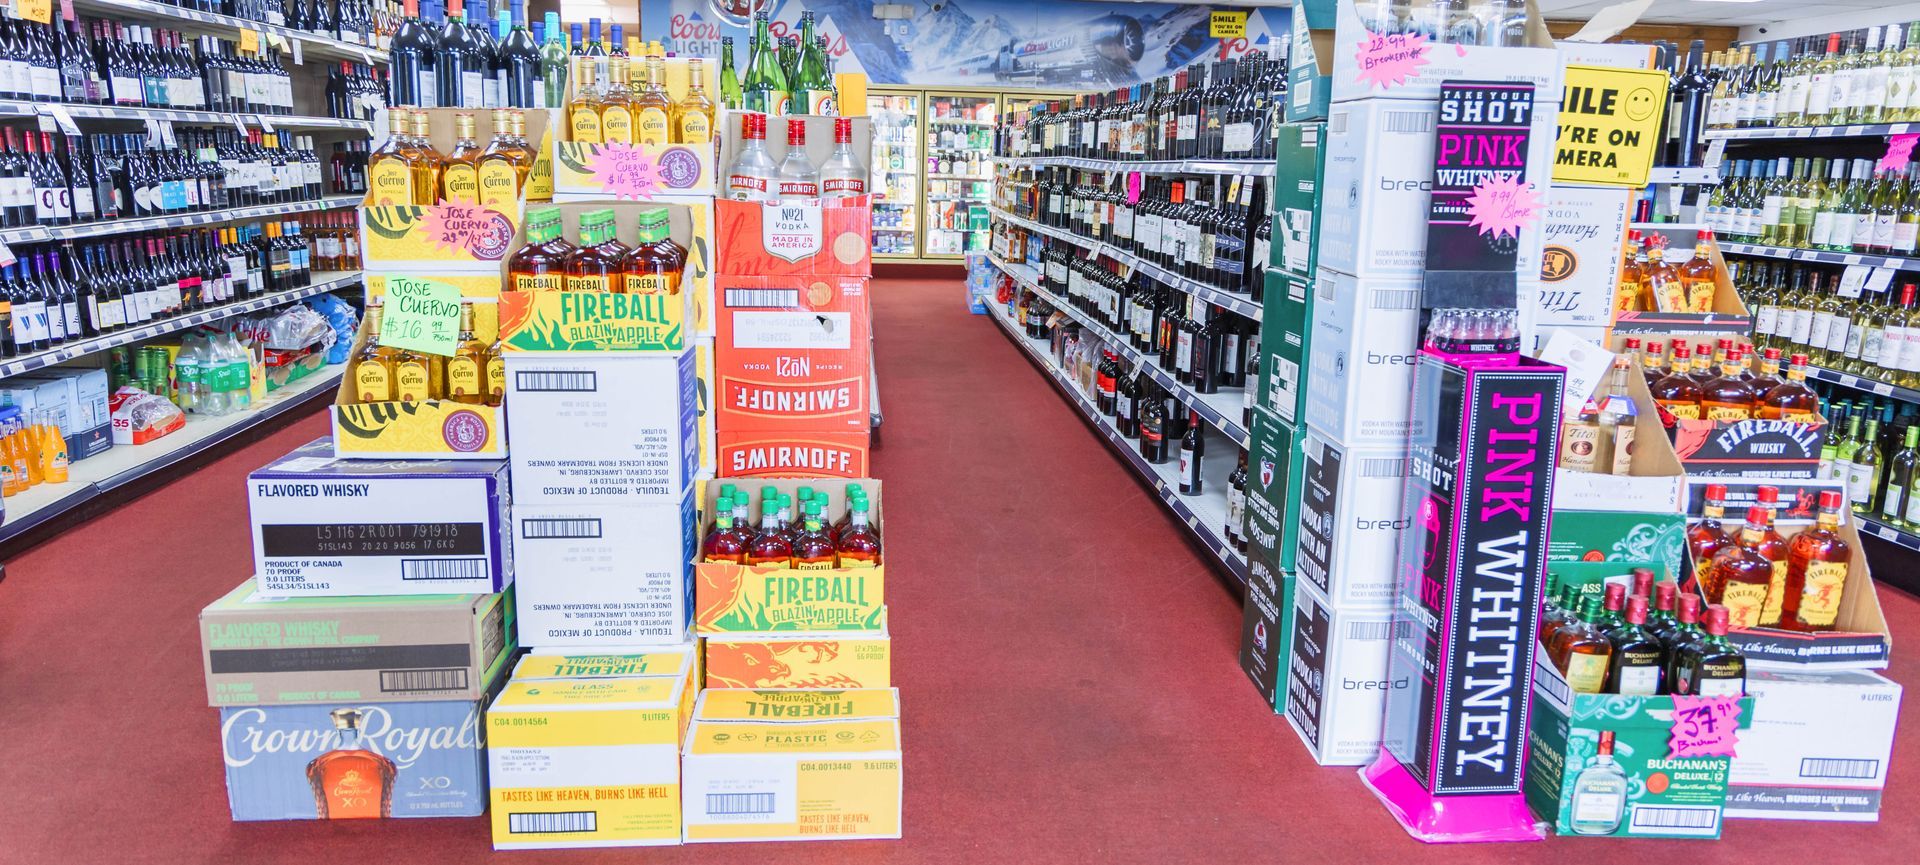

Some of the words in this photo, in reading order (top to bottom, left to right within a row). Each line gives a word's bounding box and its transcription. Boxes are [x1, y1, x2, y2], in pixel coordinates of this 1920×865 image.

[1212, 15, 1237, 23] SMILE
[670, 14, 721, 40] Coors
[674, 41, 719, 55] LIGHT
[1443, 90, 1483, 100] TAKE
[1490, 91, 1532, 101] YOUR
[1440, 100, 1530, 123] SHOT
[1608, 129, 1641, 148] ON
[610, 150, 638, 161] JOSE
[1437, 134, 1526, 167] PINK
[615, 162, 649, 173] CUERVO
[377, 174, 405, 187] Cuervo
[450, 180, 475, 192] Cuervo
[483, 175, 511, 188] Cuervo
[825, 180, 862, 190] SMIRNOFF
[440, 206, 474, 219] JOSE
[444, 219, 489, 230] CUERVO
[775, 221, 809, 230] VODKA
[391, 278, 431, 297] JOSE
[518, 278, 559, 290] FIREBALL
[569, 279, 608, 292] FIREBALL
[628, 278, 667, 291] FIREBALL
[400, 295, 459, 318] CUERVO
[561, 293, 670, 326] FIREBALL
[570, 323, 615, 341] BLAZIN'
[616, 326, 661, 343] APPLE
[361, 374, 384, 385] Cuervo
[401, 375, 424, 385] Cuervo
[452, 369, 474, 379] Cuervo
[736, 387, 850, 412] SMIRNOFF
[113, 418, 129, 428] 35
[1750, 442, 1786, 454] WHISKY
[733, 446, 851, 472] SMIRNOFF
[1480, 392, 1543, 523] PINK
[568, 468, 622, 476] LAWRENCEBURG,
[1412, 456, 1452, 491] SHOT
[258, 484, 318, 496] FLAVORED
[322, 484, 368, 496] WHISKY
[1302, 500, 1322, 536] VODKA
[1297, 550, 1328, 590] ALTITUDE
[280, 575, 306, 583] LITERS
[765, 576, 869, 608] FIREBALL
[1405, 563, 1443, 612] PINK
[816, 608, 860, 623] APPLE
[1402, 594, 1439, 633] WHITNEY
[209, 622, 281, 639] FLAVORED
[284, 620, 341, 637] WHISKY
[595, 628, 631, 636] PRODUCT
[1458, 529, 1529, 776] WHITNEY
[553, 662, 648, 676] FIREBALL
[1291, 650, 1313, 690] VODKA
[1867, 693, 1893, 702] LITERS
[746, 700, 854, 717] FIREBALL
[648, 712, 671, 721] LITERS
[1288, 699, 1317, 744] ALTITUDE
[221, 708, 342, 767] Crown
[357, 705, 477, 770] Royal
[765, 734, 828, 743] PLASTIC
[1647, 759, 1728, 770] BUCHANAN'S
[419, 776, 451, 790] XO
[502, 791, 532, 801] TASTES
[536, 790, 552, 801] LIKE
[556, 789, 592, 801] HEAVEN,
[595, 788, 624, 800] BURNS
[628, 788, 644, 798] LIKE
[648, 787, 667, 798] HELL
[342, 797, 367, 808] XO
[800, 815, 825, 824] TASTES
[827, 814, 840, 823] LIKE
[799, 825, 823, 834] BURNS
[826, 825, 839, 833] LIKE
[841, 825, 857, 833] HELL
